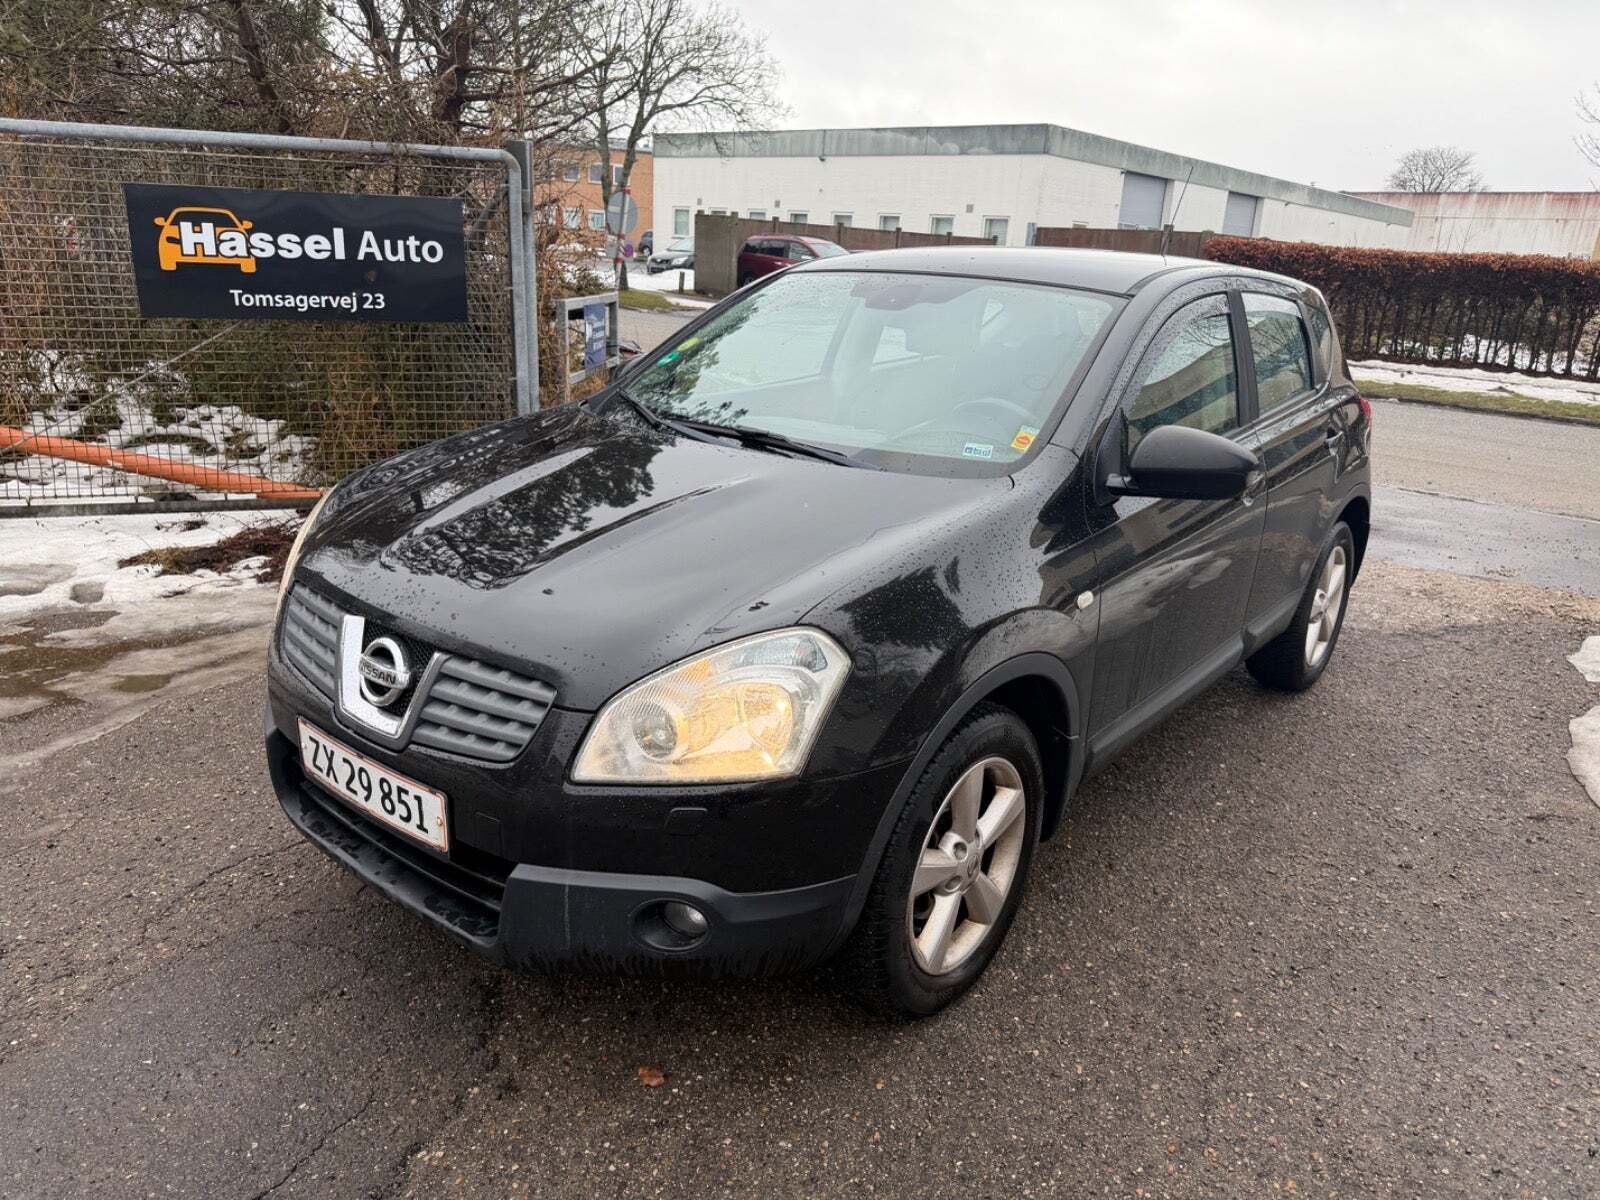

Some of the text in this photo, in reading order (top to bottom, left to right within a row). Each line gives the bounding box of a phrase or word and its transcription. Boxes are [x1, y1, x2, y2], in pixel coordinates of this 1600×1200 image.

[180, 221, 444, 263] Hassel Auto
[229, 289, 385, 312] Tomsagervej 23
[308, 735, 428, 834] ZX 29 851
